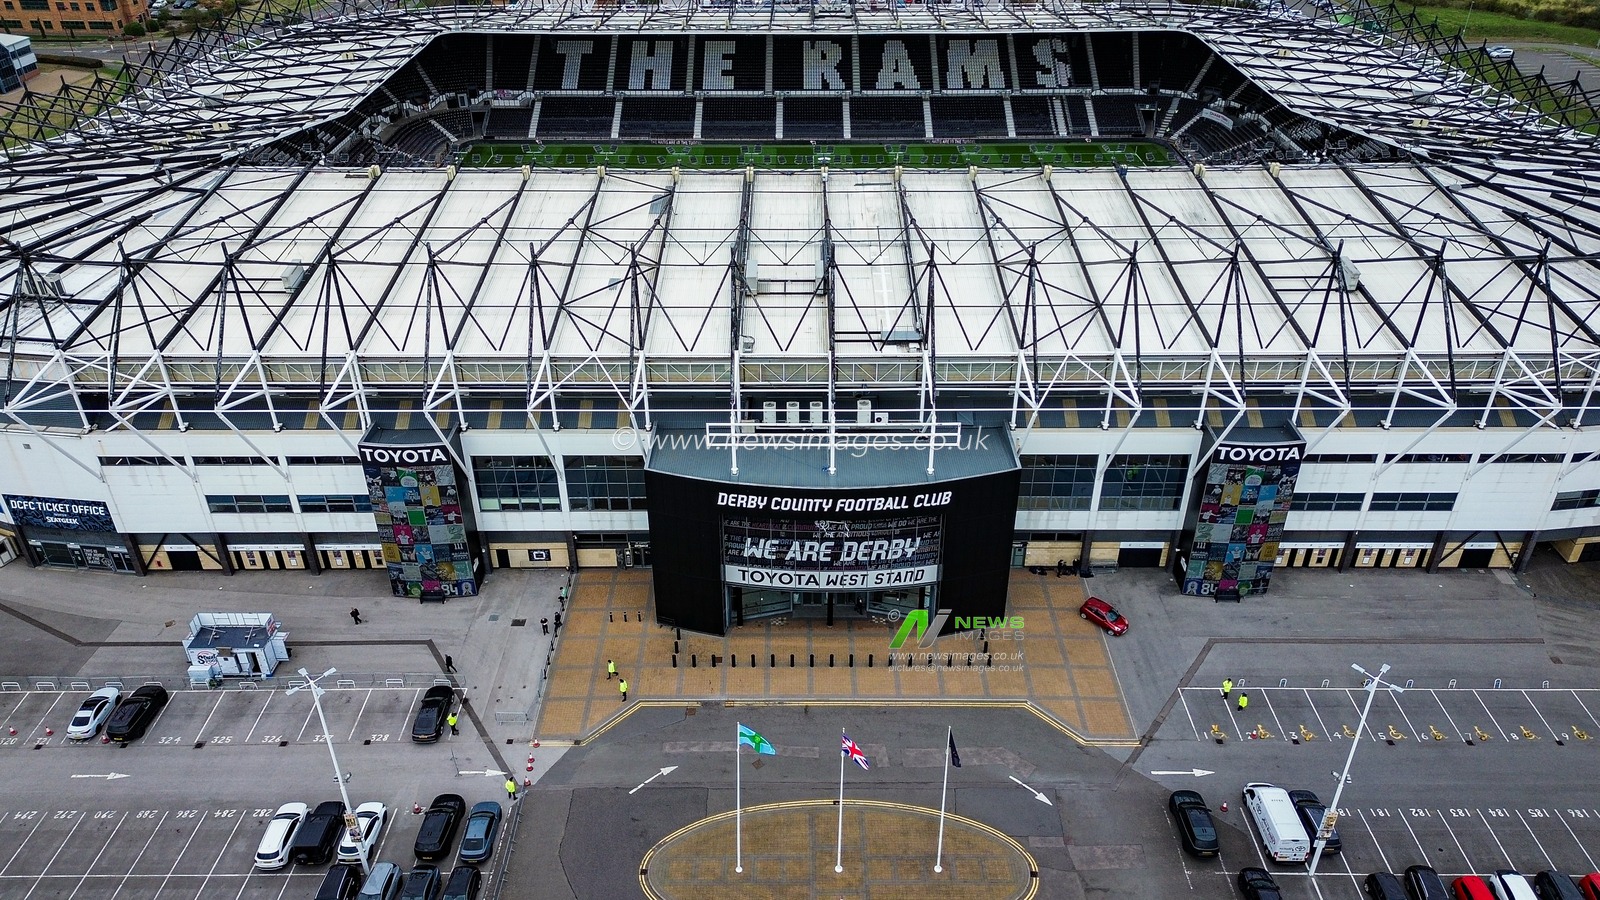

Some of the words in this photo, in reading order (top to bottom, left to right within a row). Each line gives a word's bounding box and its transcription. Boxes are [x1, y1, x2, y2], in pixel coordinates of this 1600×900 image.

[557, 41, 736, 90] THE
[803, 39, 1073, 89] RAMS
[360, 448, 448, 463] TOYOTA
[1217, 446, 1300, 461] TOYOTA
[717, 492, 768, 509] DERBY
[771, 497, 831, 511] COUNTY
[835, 496, 909, 511] FOOTBALL
[914, 491, 952, 508] CLUB
[10, 500, 36, 510] DCFC
[36, 502, 71, 513] TICKET
[71, 504, 106, 516] OFFICE
[743, 537, 780, 559] WE
[784, 541, 835, 561] ARE
[840, 536, 921, 561] DERBY
[738, 568, 820, 586] TOYOTA
[825, 572, 868, 586] WEST
[874, 569, 925, 585] STAND
[441, 583, 458, 596] 84
[211, 736, 233, 744] 325
[262, 735, 281, 743] 326
[370, 734, 390, 742] 328
[1290, 731, 1298, 740] 3
[1333, 732, 1342, 740] 4
[1378, 732, 1386, 740] 5
[1421, 733, 1428, 741] 6
[1465, 732, 1473, 741] 7
[1510, 732, 1519, 741] 8
[1561, 733, 1569, 741] 9
[14, 810, 38, 819] 294
[53, 810, 77, 819] 292
[94, 810, 117, 819] 290
[136, 810, 158, 818] 288
[176, 809, 198, 818] 286
[214, 809, 237, 818] 284
[252, 808, 273, 817] 282
[1370, 808, 1390, 817] 181
[1409, 808, 1431, 817] 182
[1449, 808, 1471, 817] 183
[1488, 808, 1510, 817] 184
[1528, 808, 1550, 818] 185
[1566, 808, 1590, 818] 186
